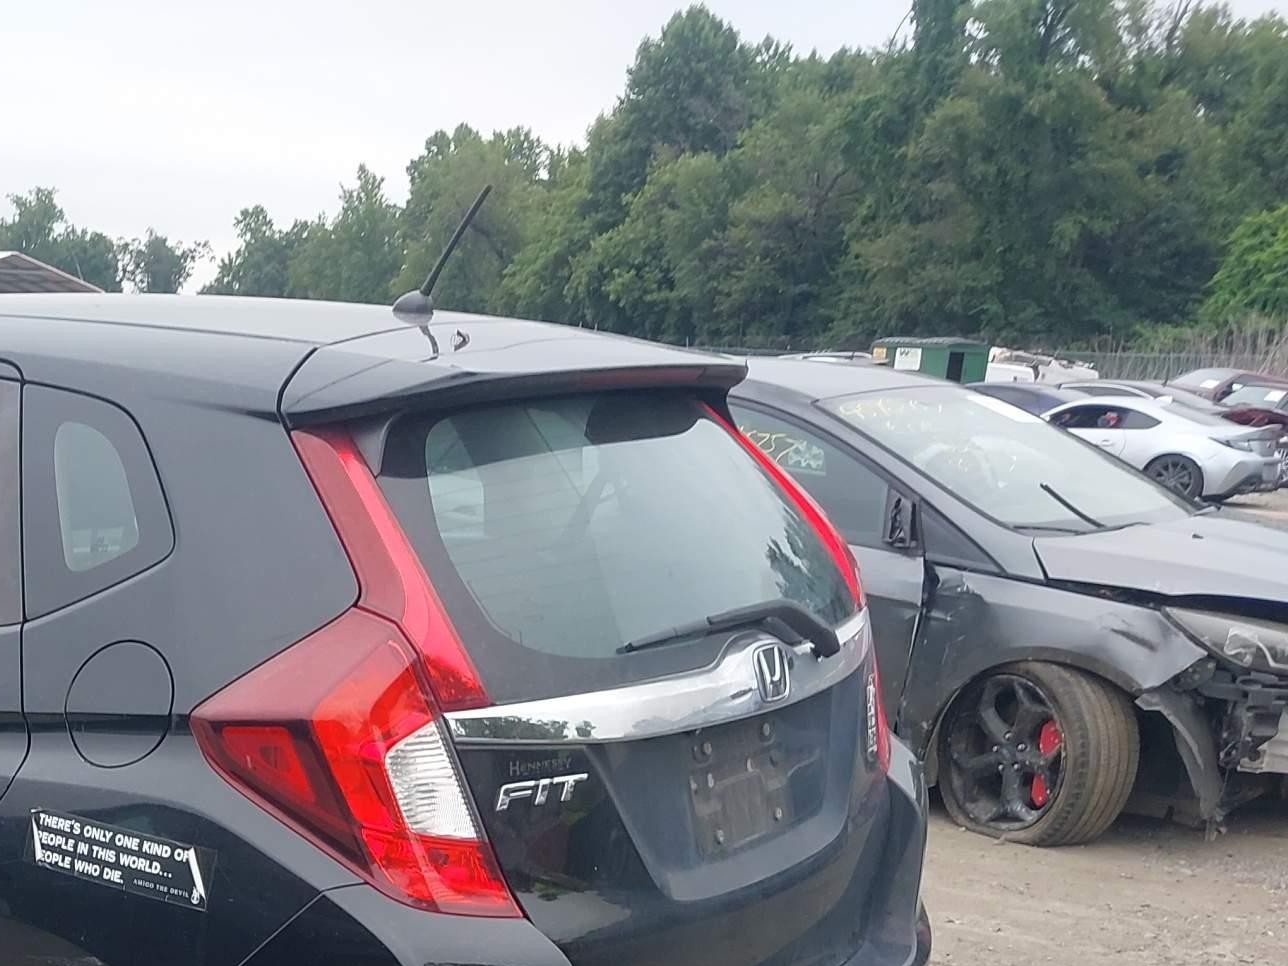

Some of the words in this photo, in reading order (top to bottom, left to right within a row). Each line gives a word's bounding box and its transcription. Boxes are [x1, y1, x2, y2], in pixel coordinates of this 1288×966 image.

[496, 772, 589, 812] FIT
[39, 812, 81, 835] THERE'S
[83, 825, 113, 843] ONLY
[115, 833, 139, 851] ONE
[142, 841, 171, 859] KIND
[77, 841, 88, 857] IN
[91, 845, 116, 863] THIS
[40, 849, 71, 869] EOPLE
[74, 859, 101, 877] WHO
[102, 866, 124, 884] DIE.
